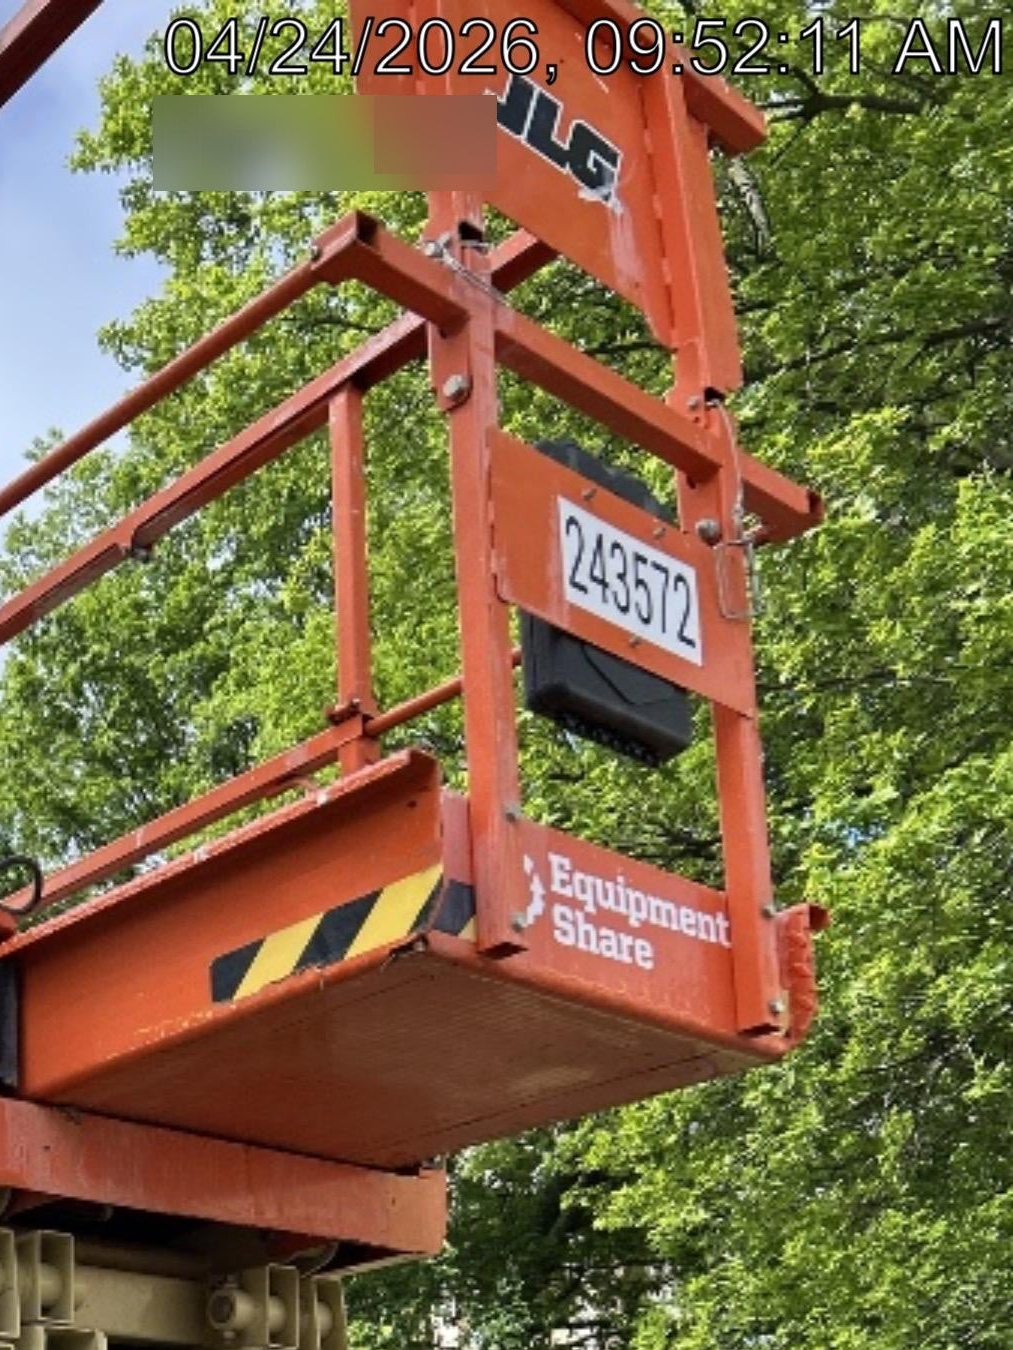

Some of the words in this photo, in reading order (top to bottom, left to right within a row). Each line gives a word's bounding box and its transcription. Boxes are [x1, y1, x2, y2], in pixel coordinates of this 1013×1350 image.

[565, 515, 697, 649] 243572
[547, 852, 731, 948] Equipment
[552, 903, 655, 970] Share
